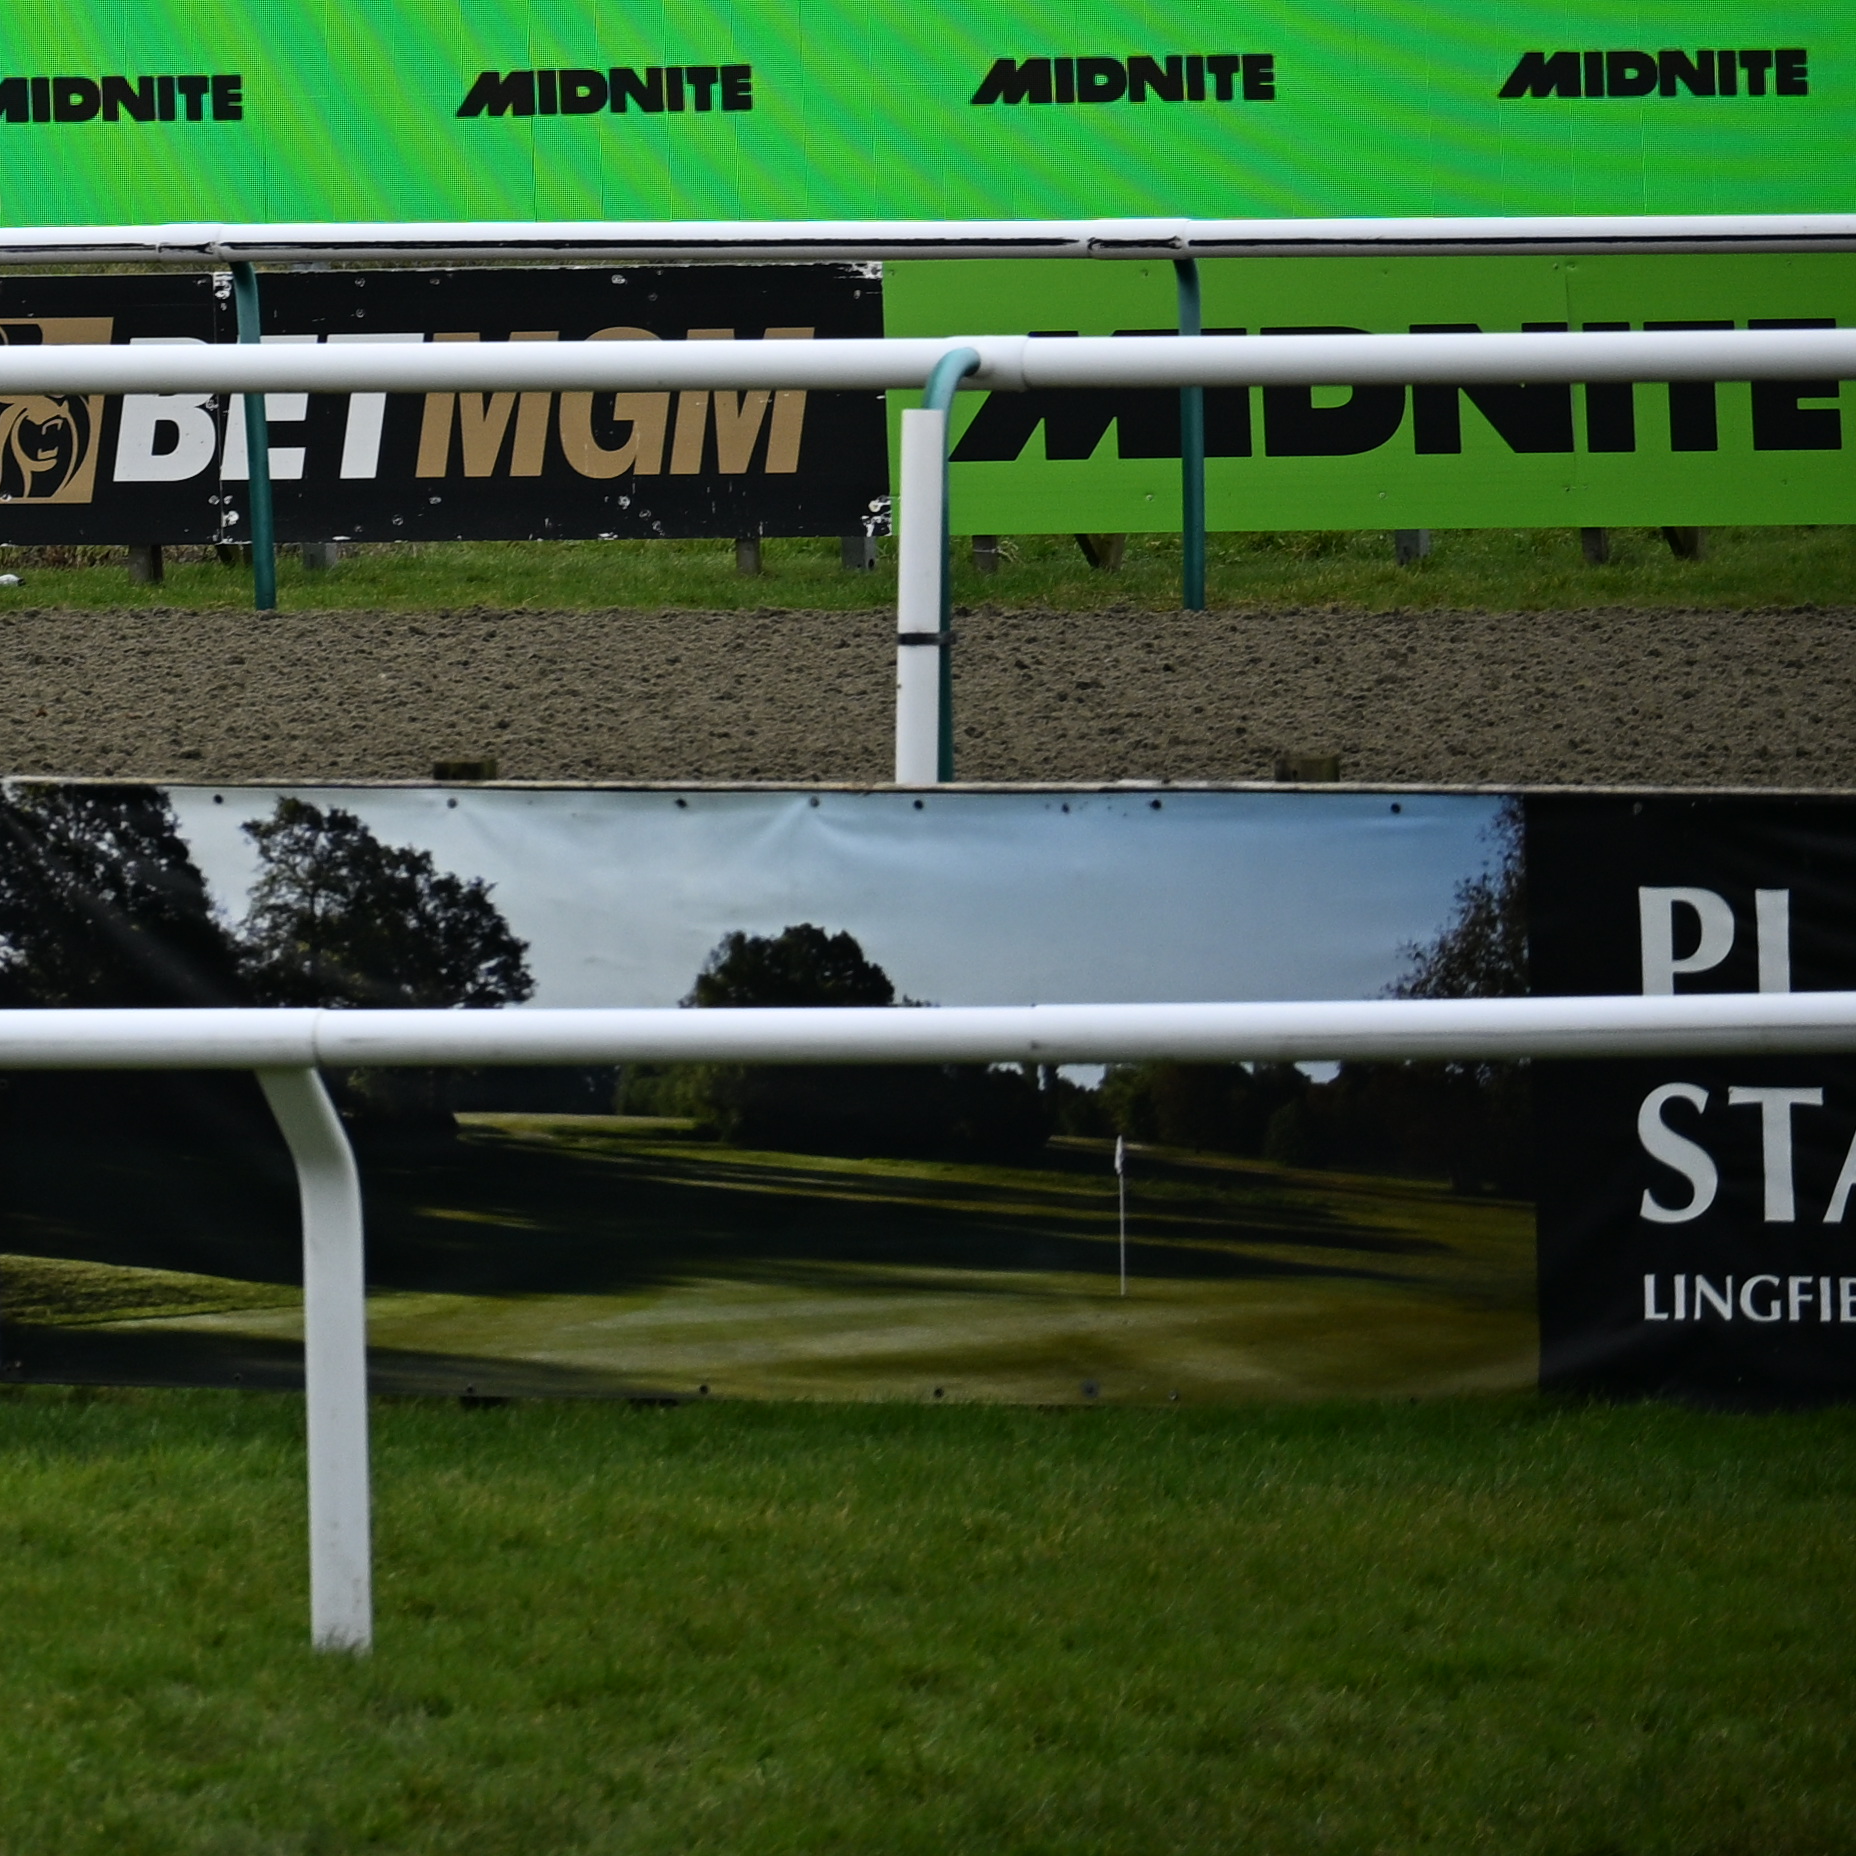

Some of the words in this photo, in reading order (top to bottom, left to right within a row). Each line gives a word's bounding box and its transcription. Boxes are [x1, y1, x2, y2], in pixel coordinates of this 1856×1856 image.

[455, 63, 753, 118] MIDNITE
[970, 52, 1277, 106] MIDNITE
[1497, 48, 1809, 99] MIDNITE
[947, 317, 1843, 462] MIDNITE
[1637, 1081, 1856, 1224] ST
